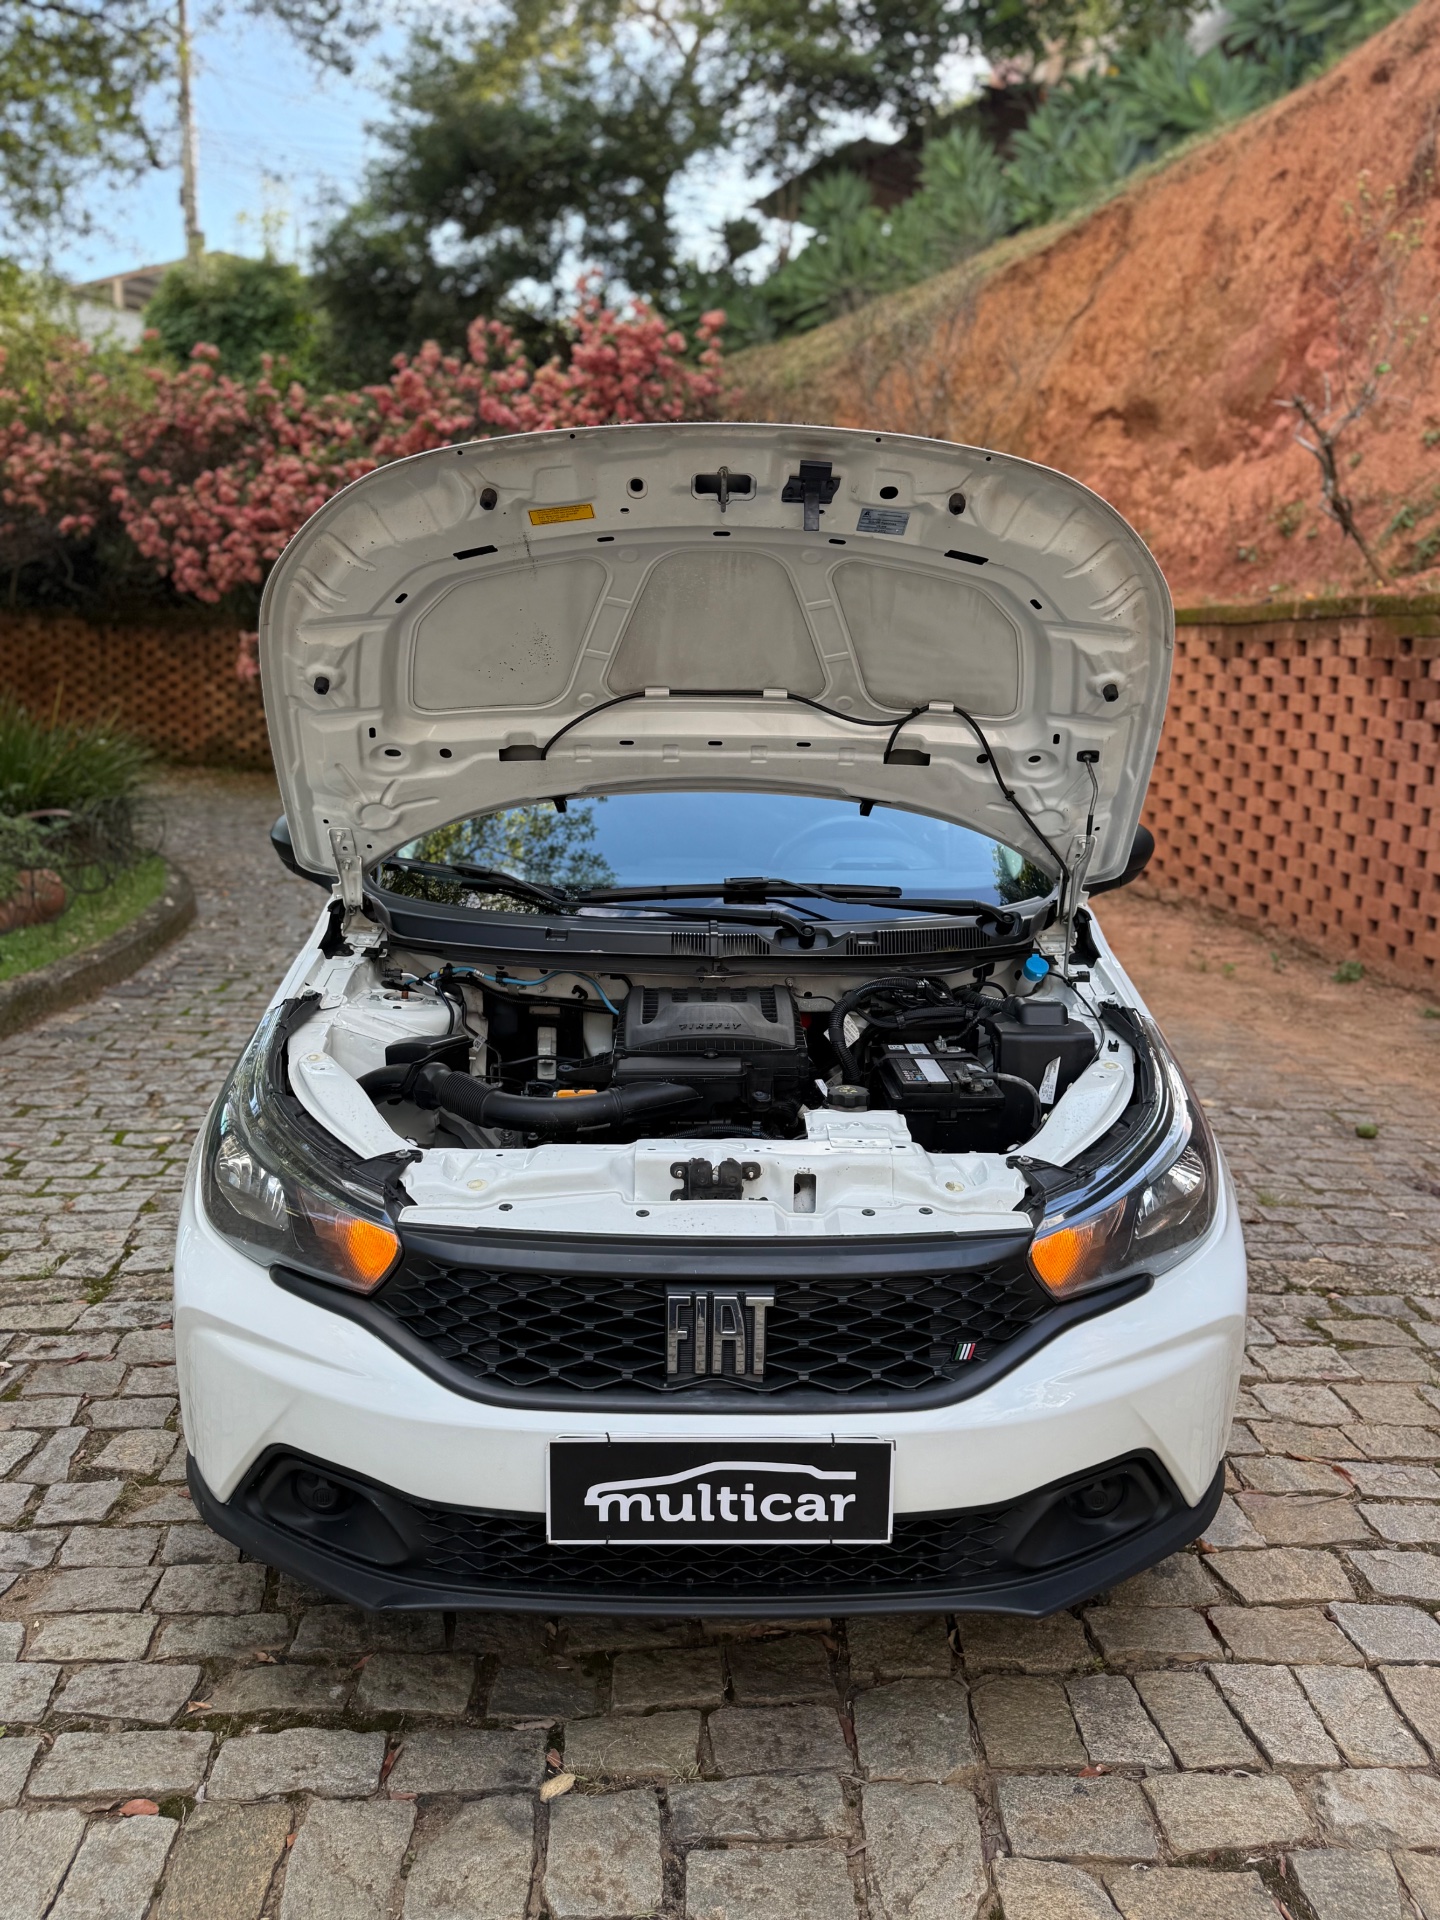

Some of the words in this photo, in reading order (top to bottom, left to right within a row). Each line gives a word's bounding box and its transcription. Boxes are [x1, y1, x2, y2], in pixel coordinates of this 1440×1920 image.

[679, 1022, 742, 1031] FIREFLY
[667, 1296, 774, 1374] FIAT
[585, 1483, 856, 1522] multicar
